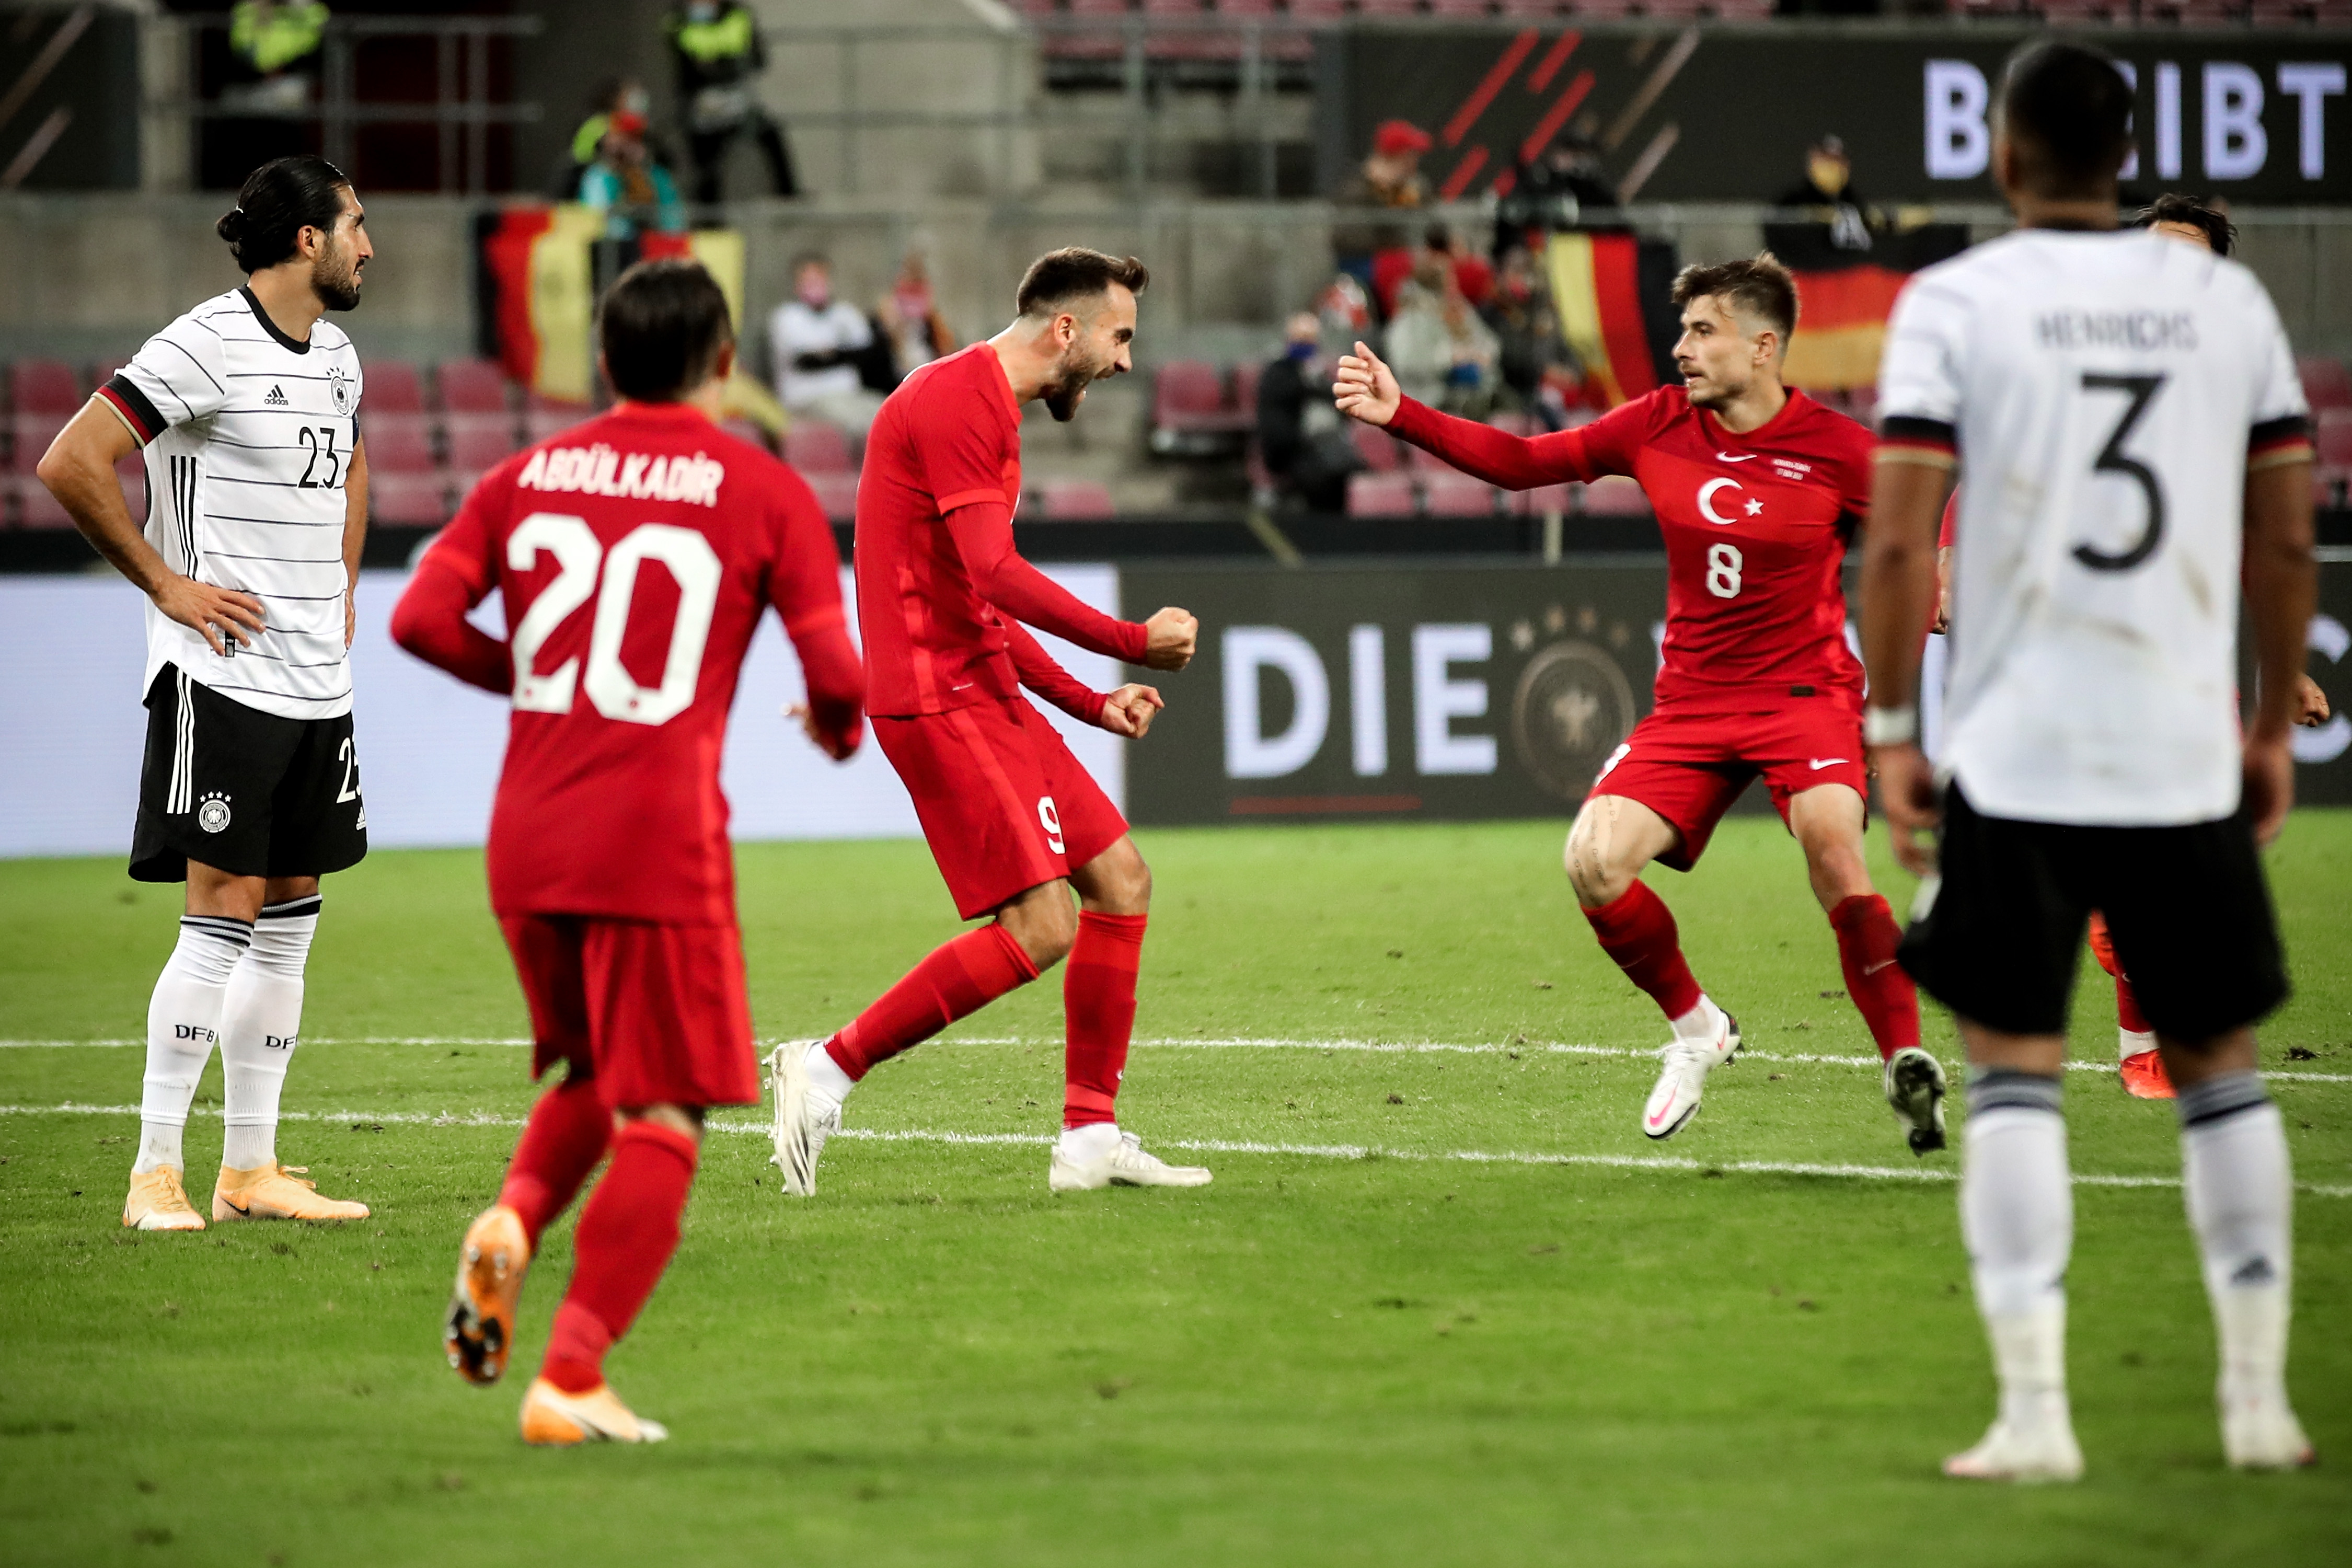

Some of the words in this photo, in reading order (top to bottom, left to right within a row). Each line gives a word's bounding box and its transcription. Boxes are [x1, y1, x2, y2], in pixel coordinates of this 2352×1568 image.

[1923, 59, 2348, 181] BIBT
[264, 397, 289, 406] adidas
[297, 426, 339, 489] 23
[517, 442, 725, 508] ABDÜLKADİR
[2071, 372, 2170, 575] 3
[1706, 543, 1743, 599] 8
[506, 512, 723, 727] 20
[1221, 622, 1498, 778] DIE
[1037, 796, 1066, 854] 9
[175, 1024, 214, 1043] DFB
[265, 1034, 297, 1050] DF
